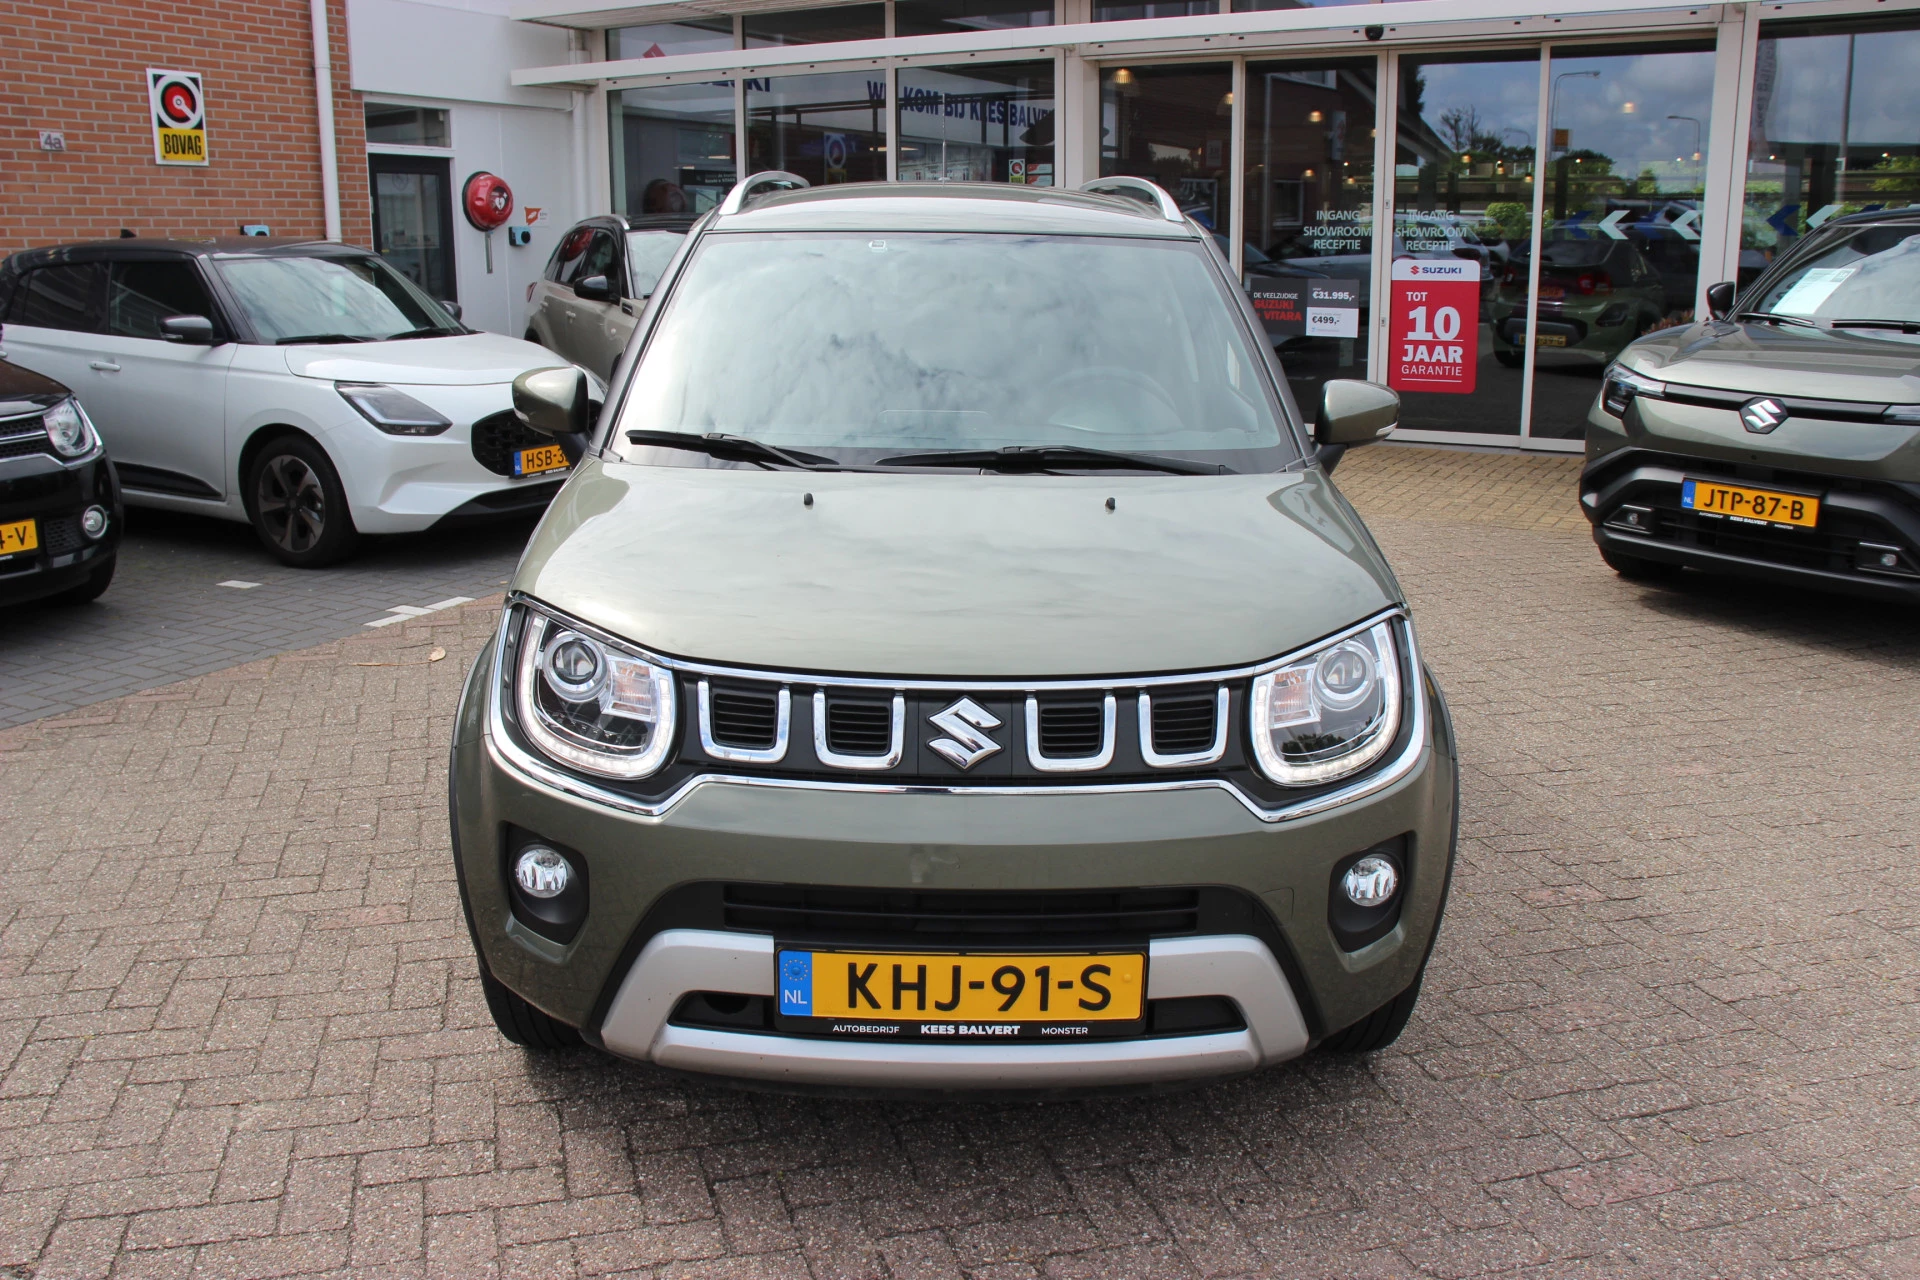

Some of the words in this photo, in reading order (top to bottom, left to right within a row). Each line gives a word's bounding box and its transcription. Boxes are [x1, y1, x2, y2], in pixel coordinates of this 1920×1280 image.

[867, 81, 938, 114] WKOM
[44, 133, 62, 149] 4a
[163, 133, 202, 155] BOVAG
[1316, 210, 1360, 221] INGANG
[1409, 211, 1454, 221] INGANG
[1303, 226, 1372, 237] SHOWROOM
[1395, 226, 1467, 238] SHOWROOM
[1313, 239, 1361, 250] RECEPTIE
[1406, 240, 1455, 251] RECEPTIE
[1422, 266, 1462, 274] SUZUKI
[1312, 291, 1355, 301] €31.995,-
[1406, 292, 1428, 301] TOT
[1254, 300, 1294, 309] SUZUKI
[1264, 311, 1302, 320] VITARA
[1312, 316, 1340, 325] €499,-
[1407, 306, 1461, 340] 10
[1402, 344, 1463, 363] JAAR
[1401, 365, 1462, 376] GARANTIE
[526, 448, 565, 469] HSB-3
[1704, 489, 1804, 520] JTP-87-B
[848, 962, 1111, 1011] KHJ-91-S
[784, 989, 808, 1004] NL
[832, 1025, 900, 1034] AUTOBEDRIJF
[921, 1025, 955, 1034] KEES
[959, 1025, 1020, 1035] BALVERT
[1041, 1027, 1089, 1035] MONSTER
